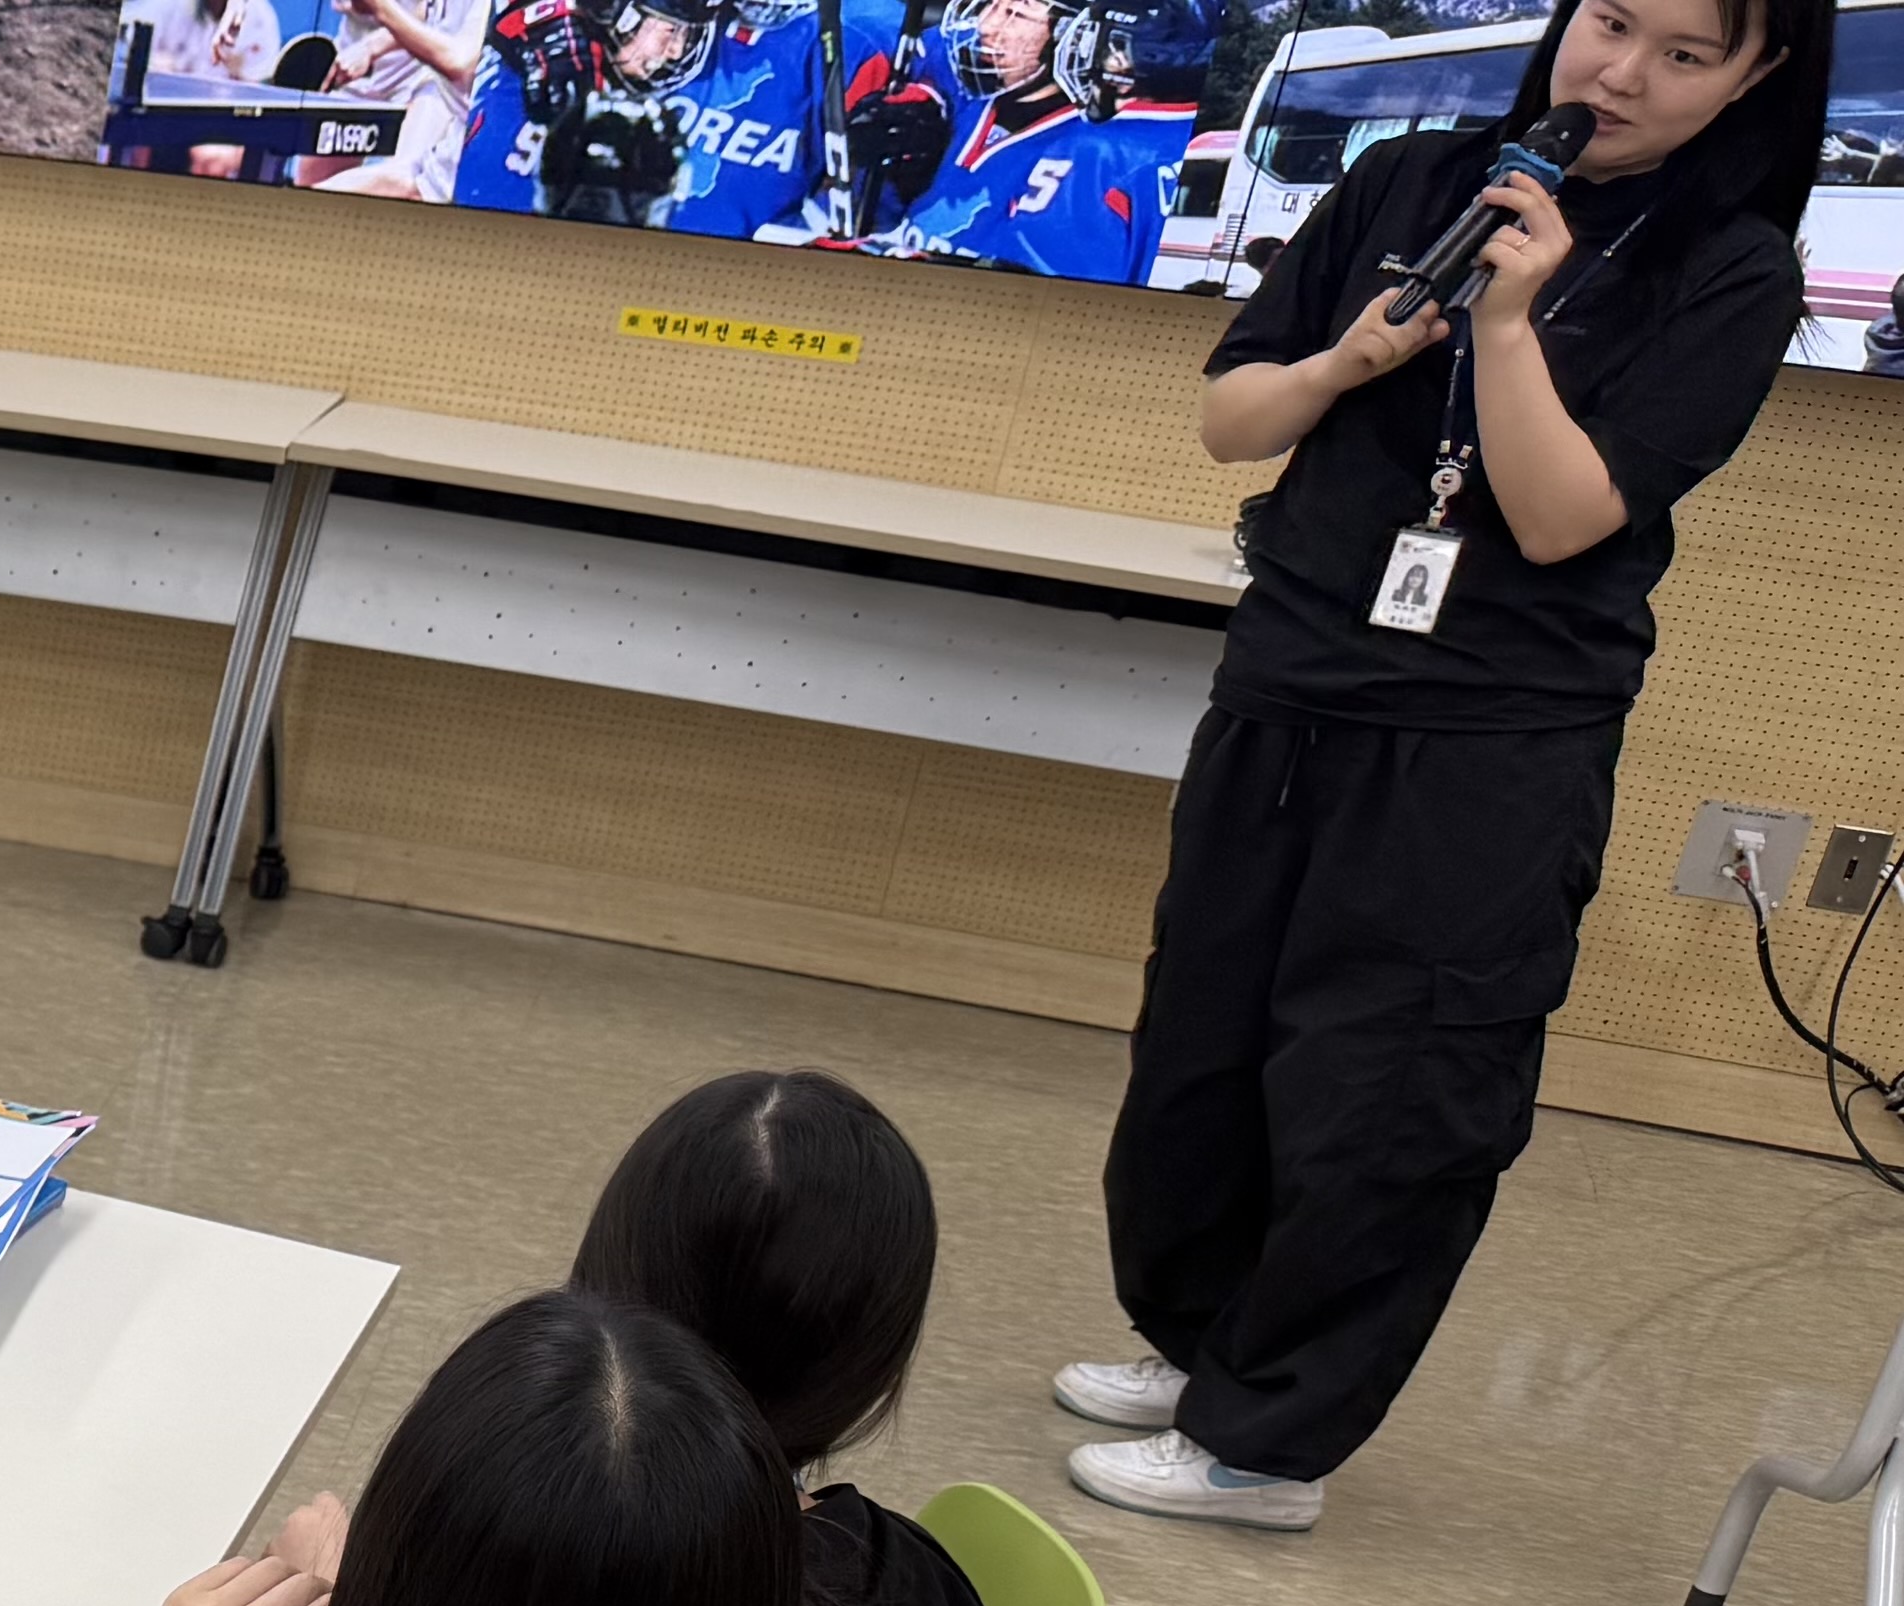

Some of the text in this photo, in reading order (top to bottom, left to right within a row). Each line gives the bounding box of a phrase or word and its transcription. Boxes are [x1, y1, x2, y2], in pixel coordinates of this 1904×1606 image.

[662, 96, 800, 174] OREA
[741, 327, 779, 348] 파손
[789, 333, 826, 353] 주의
